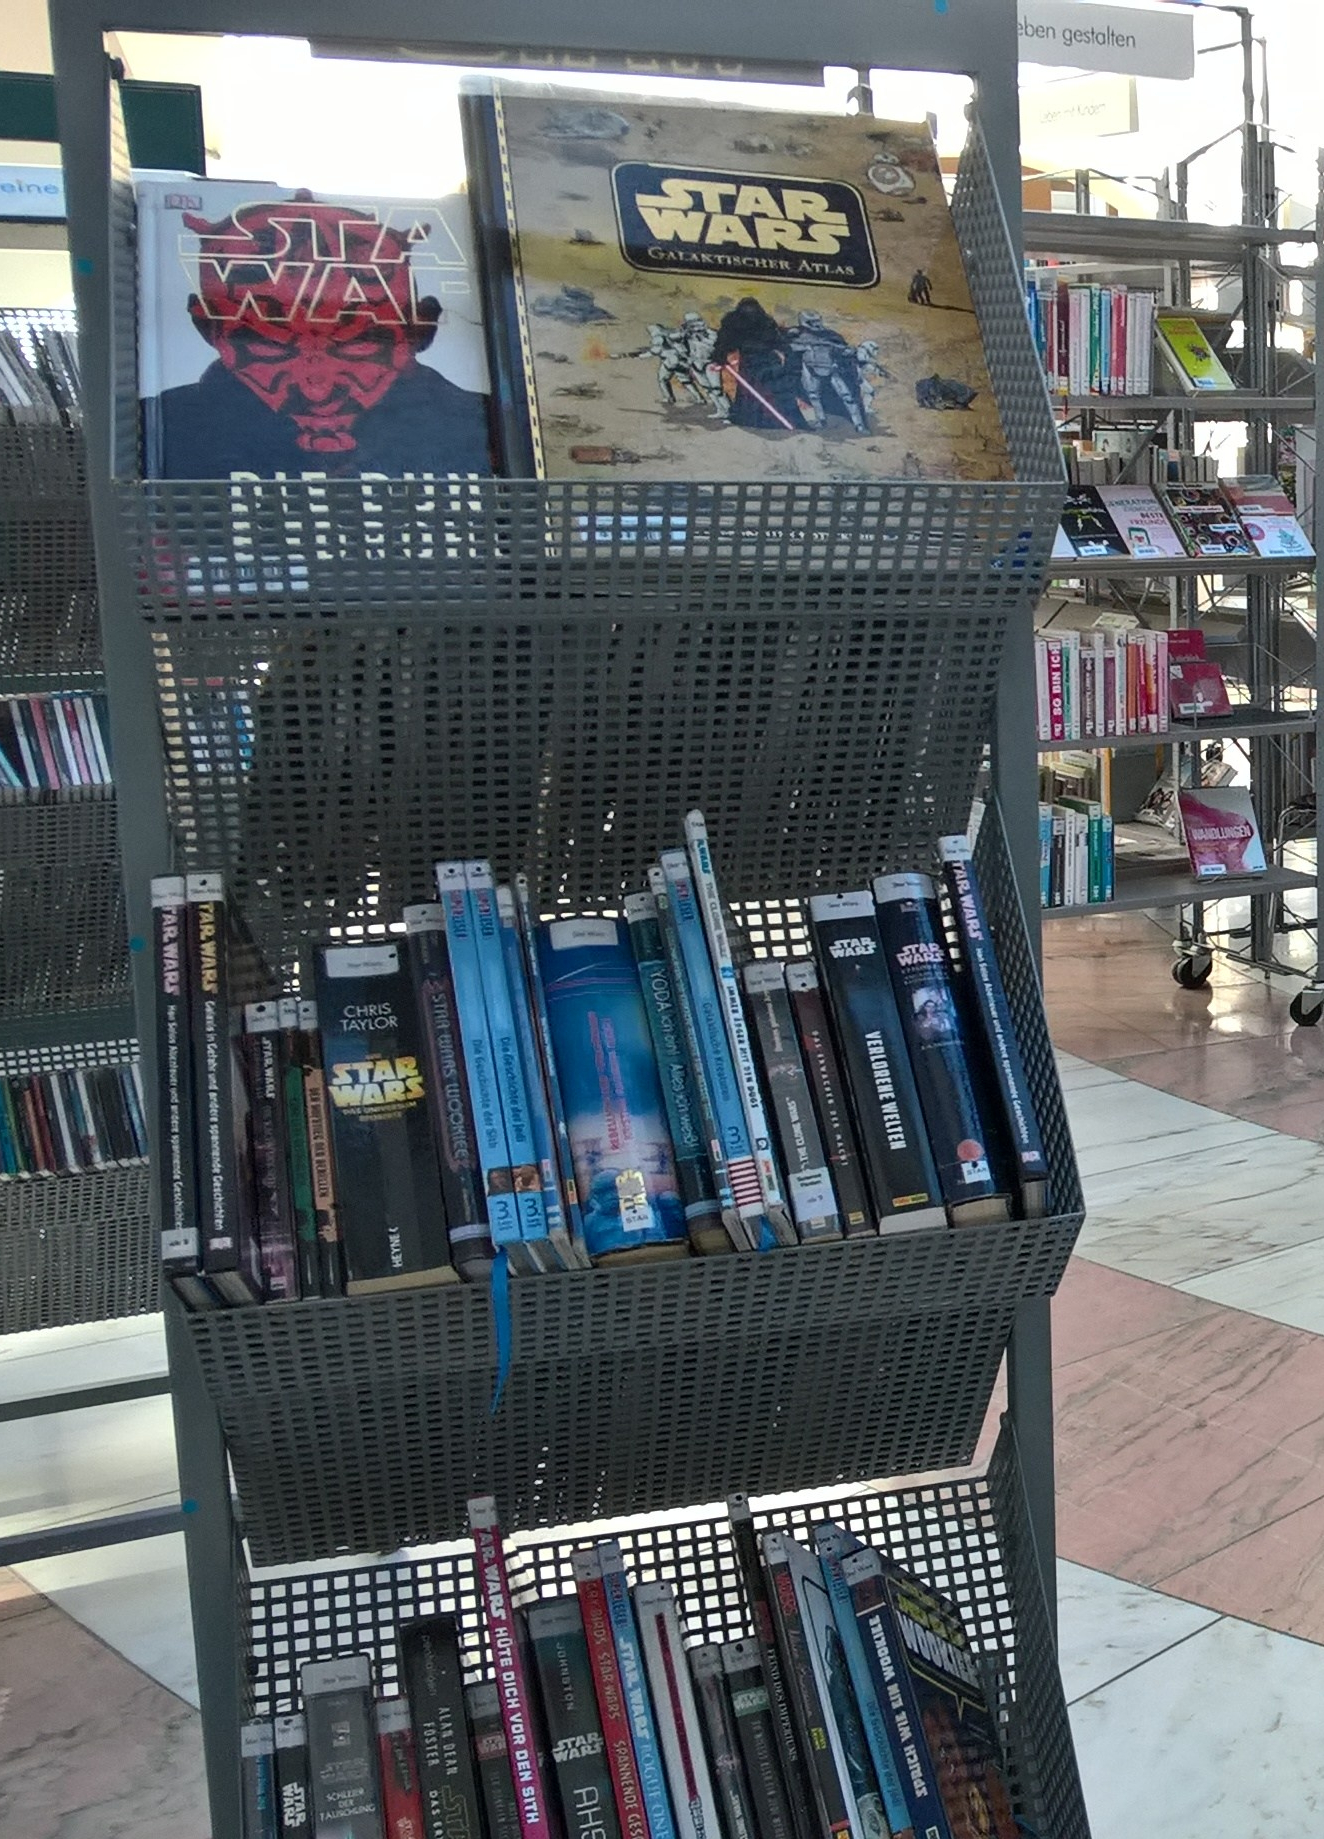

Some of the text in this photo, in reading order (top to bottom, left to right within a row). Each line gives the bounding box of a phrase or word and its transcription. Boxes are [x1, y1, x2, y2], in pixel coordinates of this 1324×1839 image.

[1017, 16, 1136, 48] eben gestalten
[636, 178, 848, 225] STAR
[638, 207, 851, 255] WARS
[1052, 673, 1063, 695] BIN
[1052, 696, 1063, 710] SO
[161, 904, 180, 944] TAR
[198, 901, 216, 942] TAR
[829, 937, 876, 951] STAR
[830, 945, 876, 960] WARS
[897, 949, 945, 968] WARS
[898, 942, 944, 956] STAR
[162, 944, 181, 997] WARS
[200, 941, 218, 995] WARS
[339, 1016, 399, 1032] TAYLOR
[343, 1002, 393, 1019] CHRIS
[650, 967, 673, 1013] YODA
[669, 1062, 686, 1093] Alles
[332, 1056, 419, 1086] STAR
[864, 1030, 908, 1151] VERLORENE WELTEN
[208, 1092, 220, 1122] andere
[328, 1076, 427, 1109] WARS
[171, 1134, 182, 1180] spannende
[210, 1123, 222, 1174] spannende
[212, 1175, 225, 1232] Geschichten
[484, 1562, 507, 1621] WARS
[493, 1626, 514, 1668] HÜTE
[597, 1651, 614, 1682] STAR
[618, 1637, 640, 1688] STAR
[501, 1670, 522, 1710] DICH
[603, 1682, 621, 1721] WARS
[867, 1613, 929, 1799] SPRICH WIE EIN WOOKIEE
[508, 1712, 527, 1746] VOR
[628, 1687, 651, 1740] WARS
[422, 1721, 441, 1768] FOSTER
[552, 1743, 604, 1763] WARS
[553, 1731, 603, 1753] STAR
[514, 1747, 533, 1783] DEN
[613, 1739, 639, 1811] SPANNENDE
[638, 1744, 662, 1799] ROGUE
[282, 1781, 301, 1829] WARS
[295, 1784, 307, 1826] STAR
[520, 1787, 540, 1825] SITH
[650, 1803, 671, 1839] ONE
